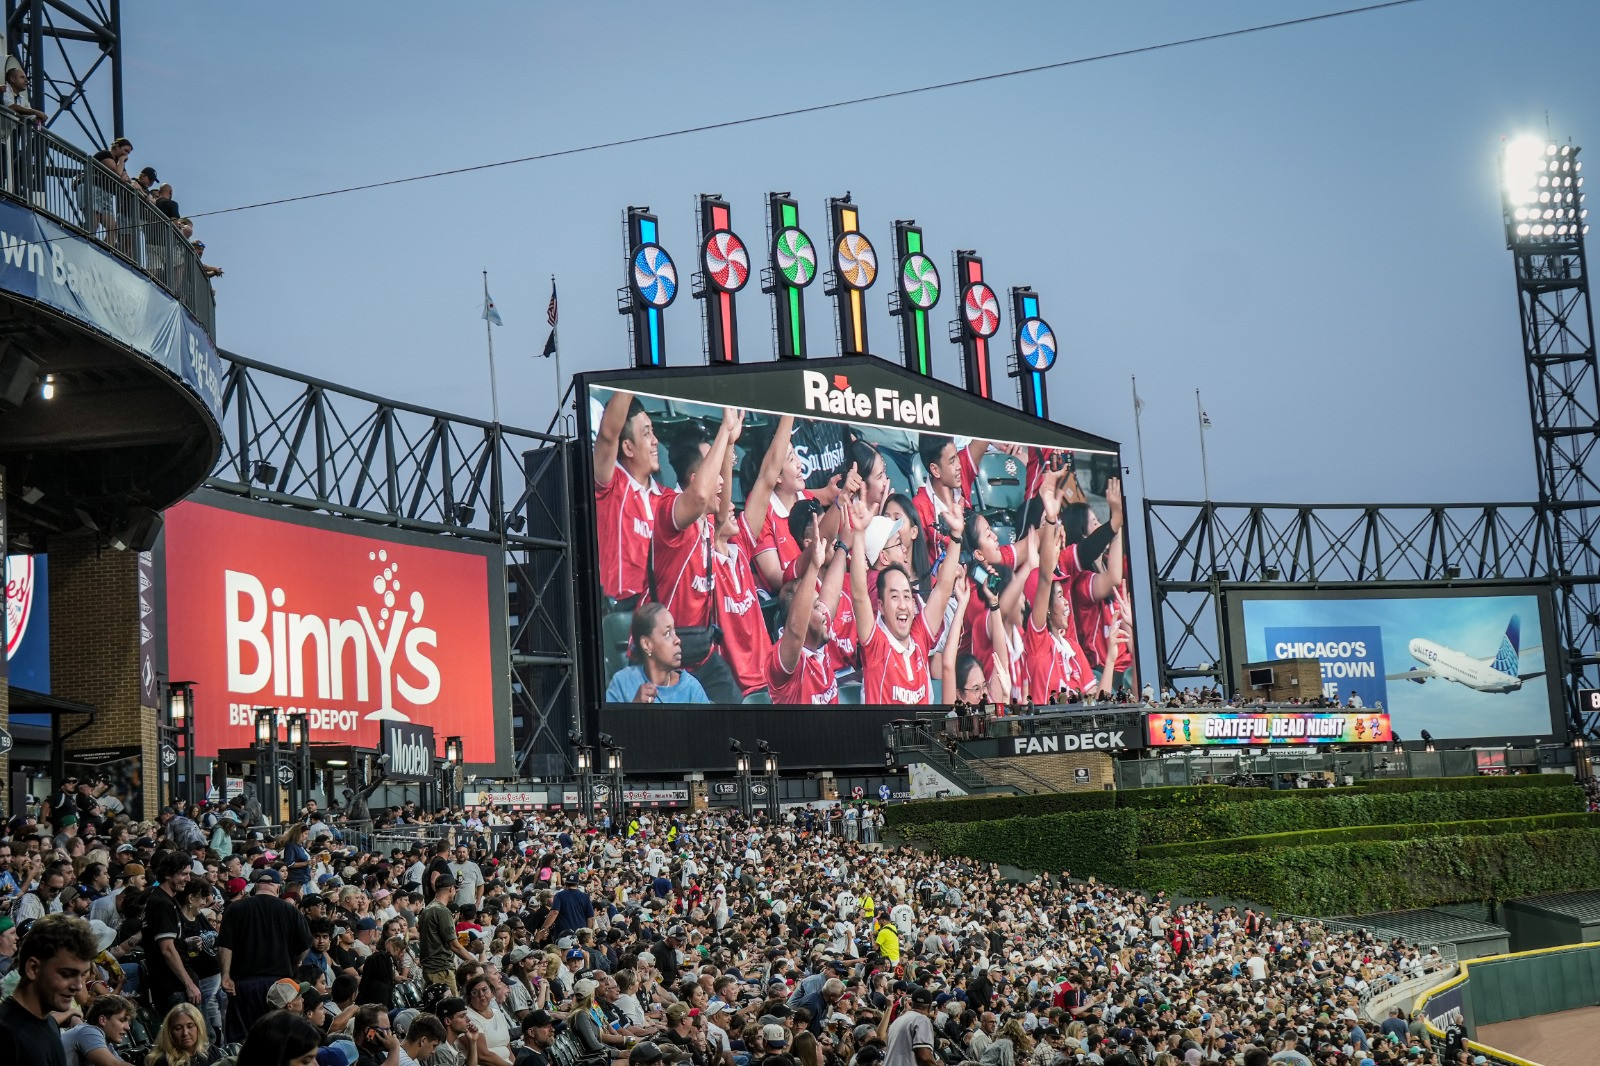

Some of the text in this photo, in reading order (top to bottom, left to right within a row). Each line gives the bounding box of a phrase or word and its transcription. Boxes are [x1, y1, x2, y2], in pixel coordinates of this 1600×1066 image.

[803, 370, 941, 427] Rate Field
[794, 441, 845, 480] Southsid
[225, 569, 441, 721] Binny's
[1275, 641, 1367, 659] CHICAGO'S
[1320, 662, 1376, 678] ETOWN
[229, 703, 358, 730] BEVA DEPOT
[1204, 717, 1346, 739] GRATEFUL DEAD NIGHT
[390, 728, 429, 775] Modelo
[1014, 731, 1126, 754] FAN DECK
[843, 896, 854, 906] 72
[902, 913, 907, 922] 5
[1448, 1034, 1455, 1044] 5
